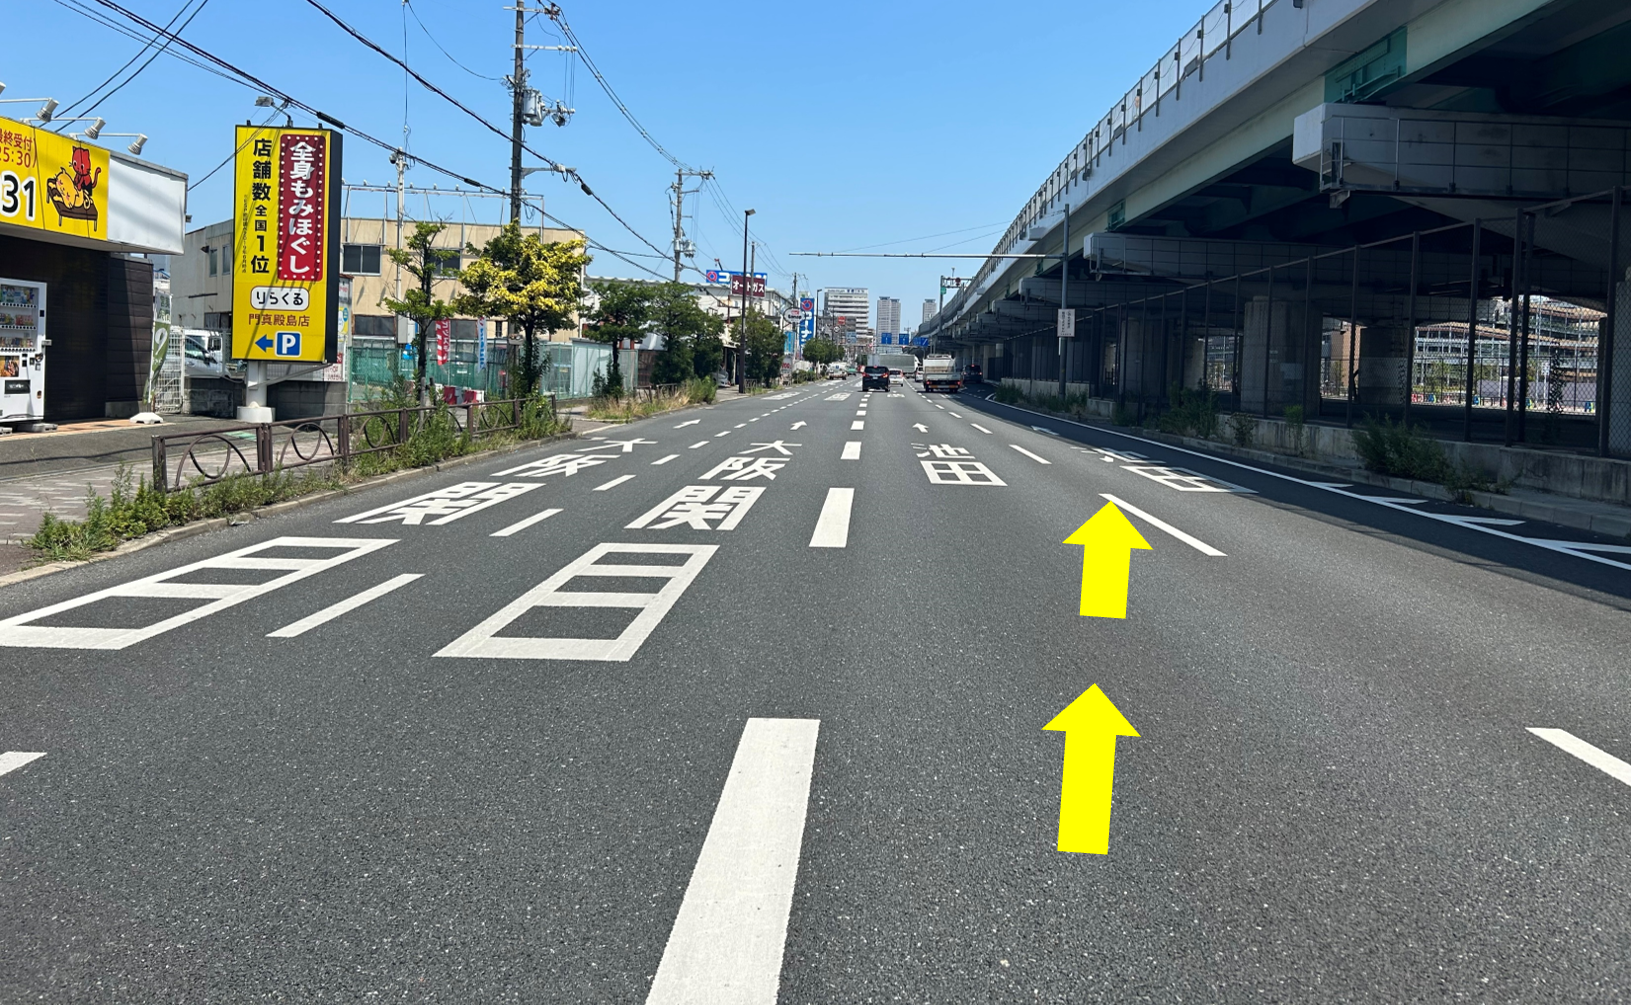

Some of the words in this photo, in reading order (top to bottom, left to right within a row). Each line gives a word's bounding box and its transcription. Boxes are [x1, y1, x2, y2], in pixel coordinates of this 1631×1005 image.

[0, 128, 32, 152] 終受付
[251, 138, 272, 274] 店舗数全国1位
[288, 141, 316, 274] 全身もみほぐし
[732, 280, 765, 293] オートガス
[256, 291, 304, 306] りらくる
[248, 313, 311, 328] 門真殿島店
[281, 335, 297, 354] P
[910, 443, 1009, 486] 池田
